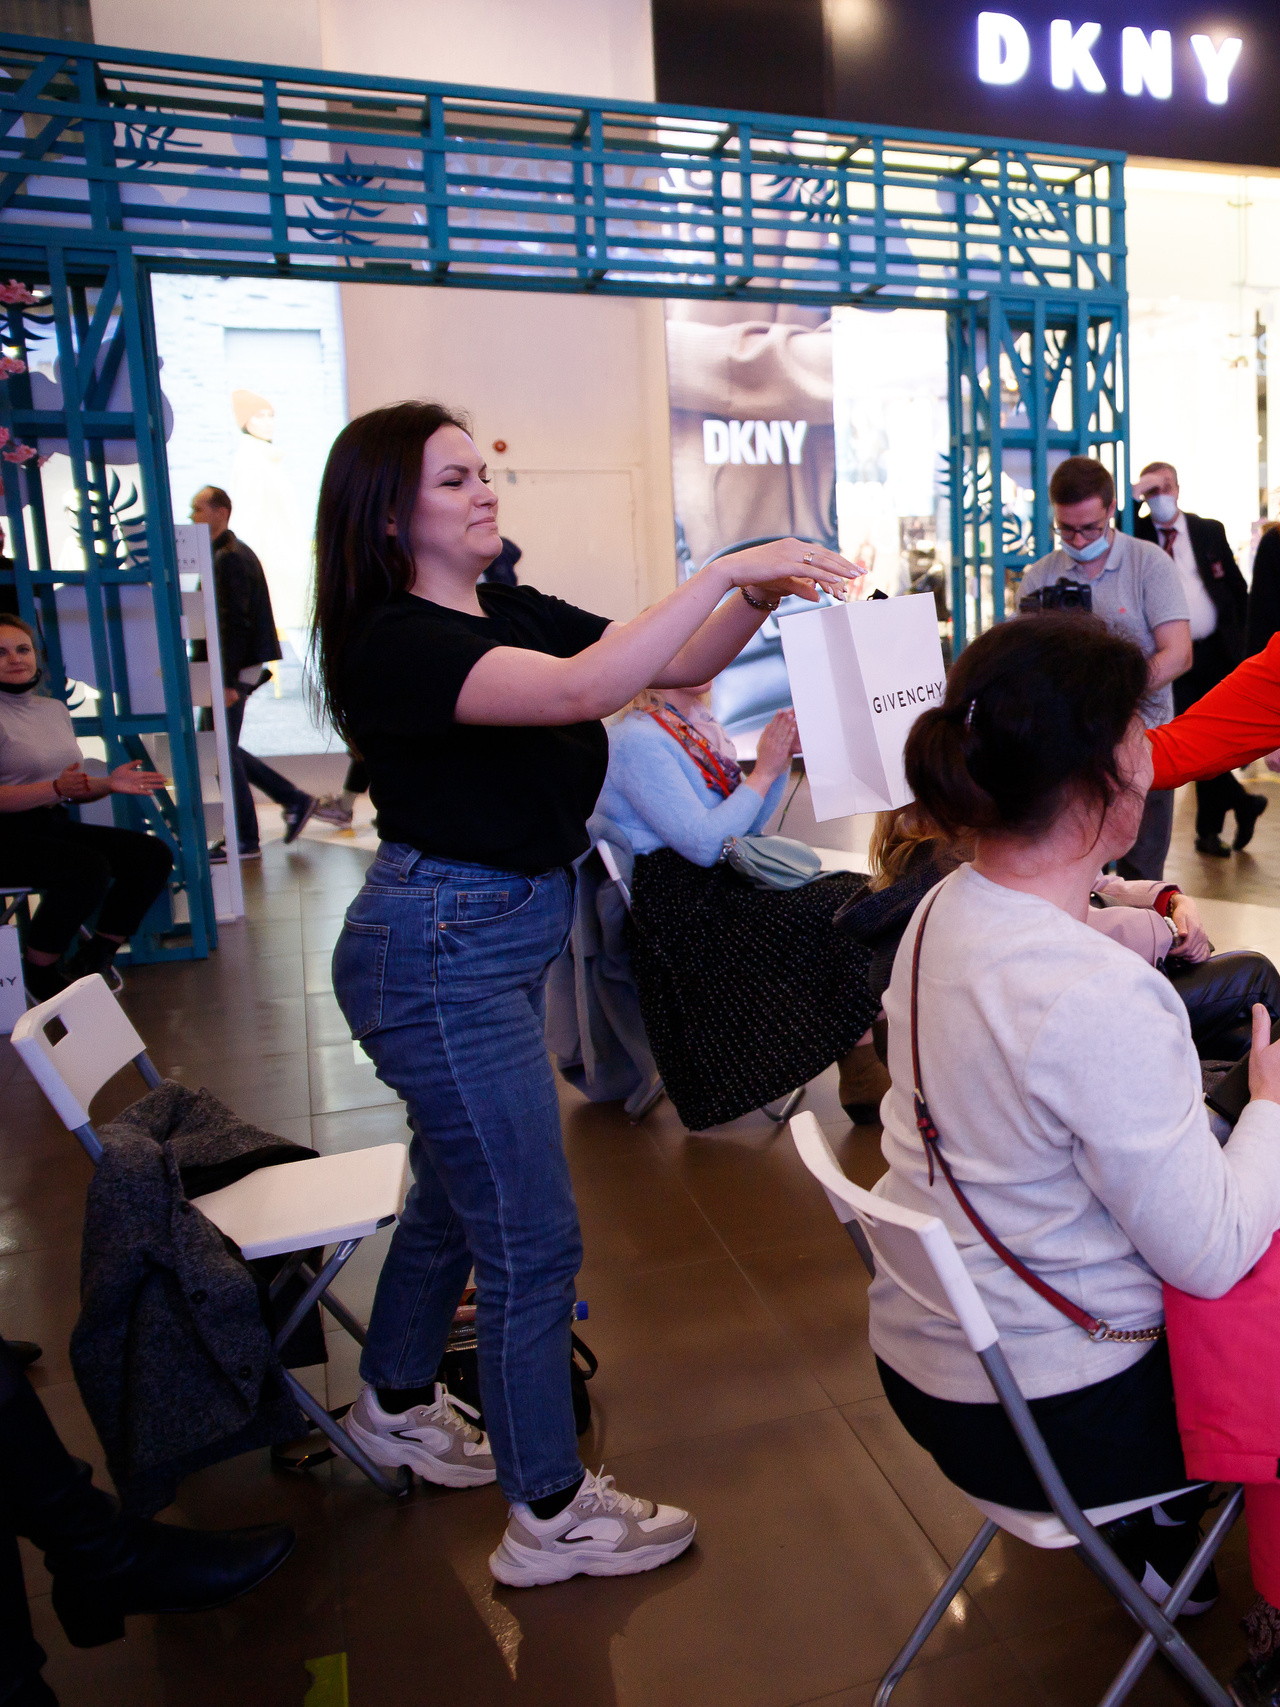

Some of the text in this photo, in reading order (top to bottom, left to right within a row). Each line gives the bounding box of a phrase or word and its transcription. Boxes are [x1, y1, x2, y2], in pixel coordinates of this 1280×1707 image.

[977, 11, 1243, 105] DKNY
[703, 420, 807, 465] DKNY
[872, 681, 943, 714] GIVENCHY
